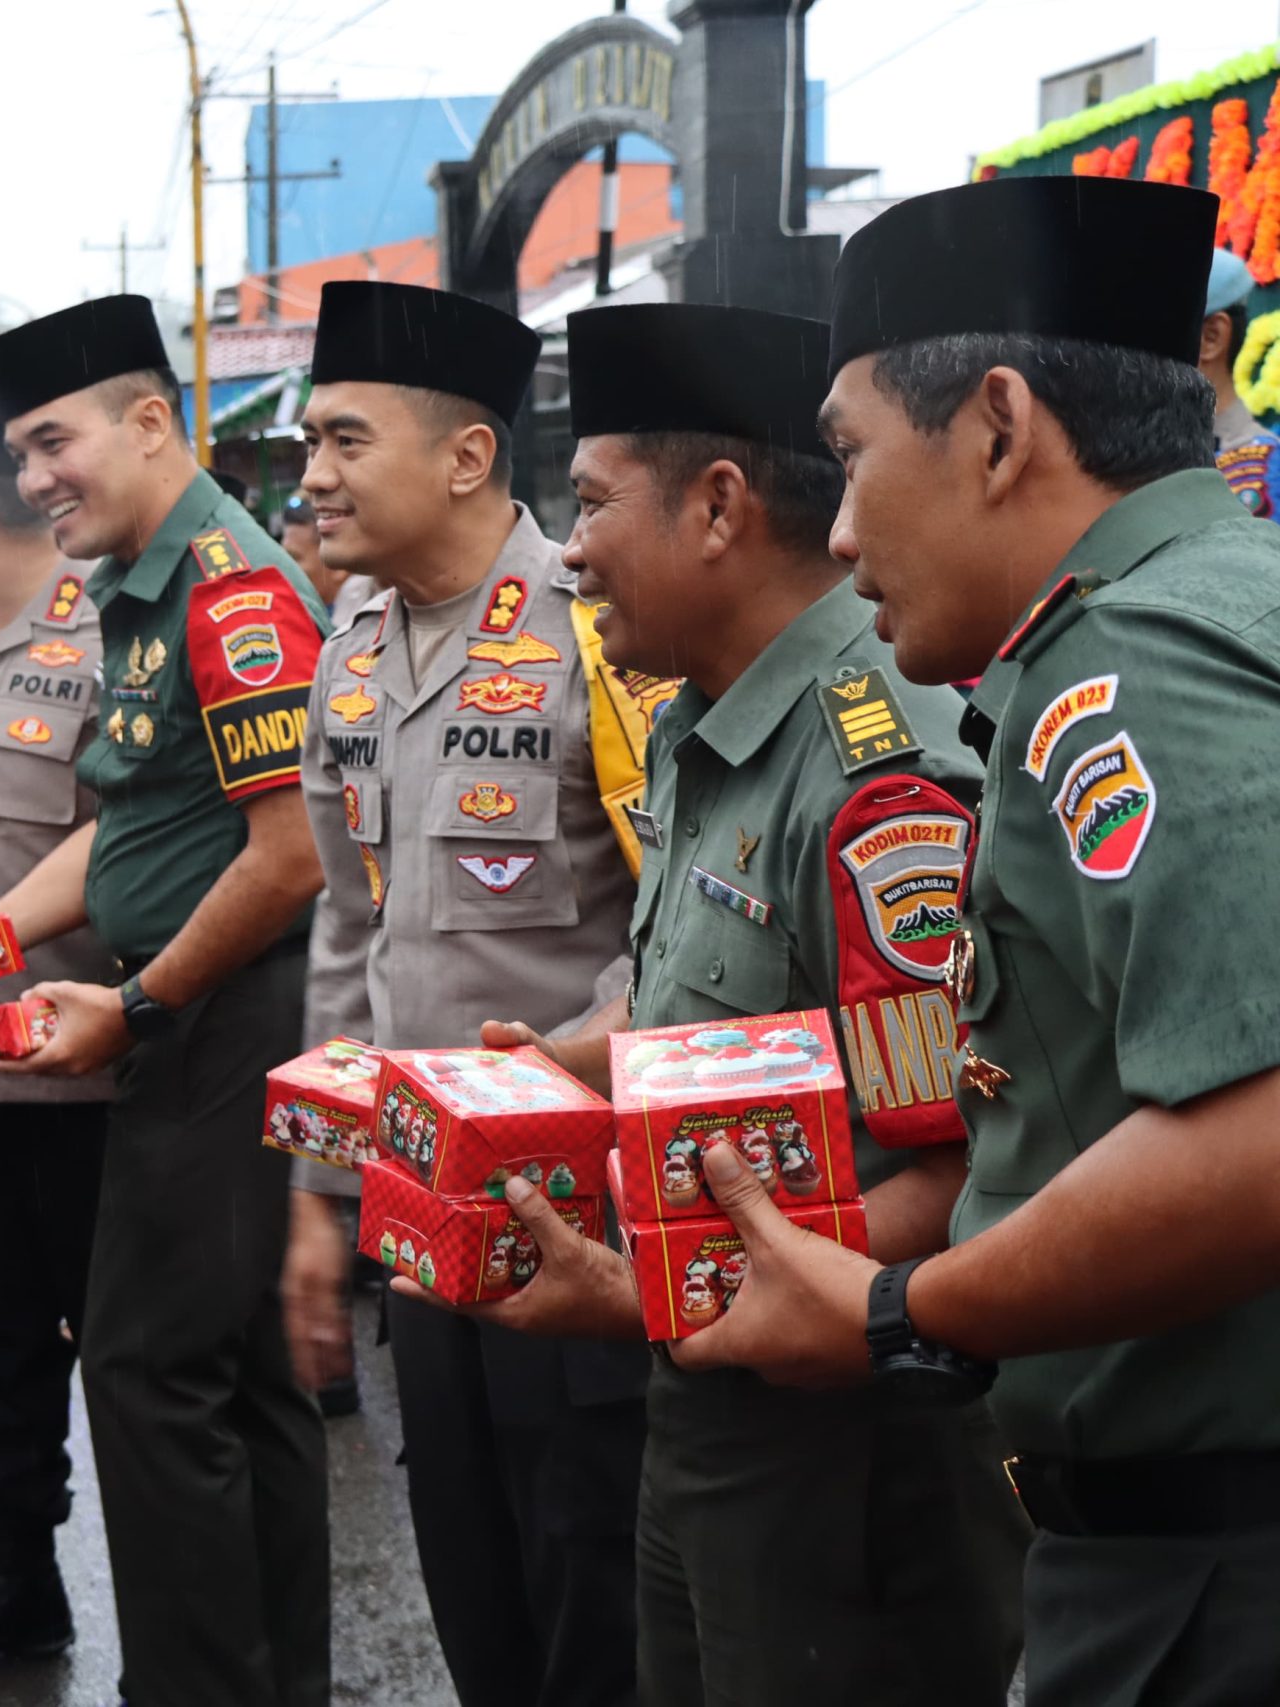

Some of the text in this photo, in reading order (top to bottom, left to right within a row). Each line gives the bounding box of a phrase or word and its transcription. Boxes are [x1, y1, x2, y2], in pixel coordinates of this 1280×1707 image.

[9, 673, 83, 701] POLRI
[1076, 683, 1107, 709] 023
[443, 726, 551, 760] POLRI
[1078, 754, 1121, 788] BARISAN
